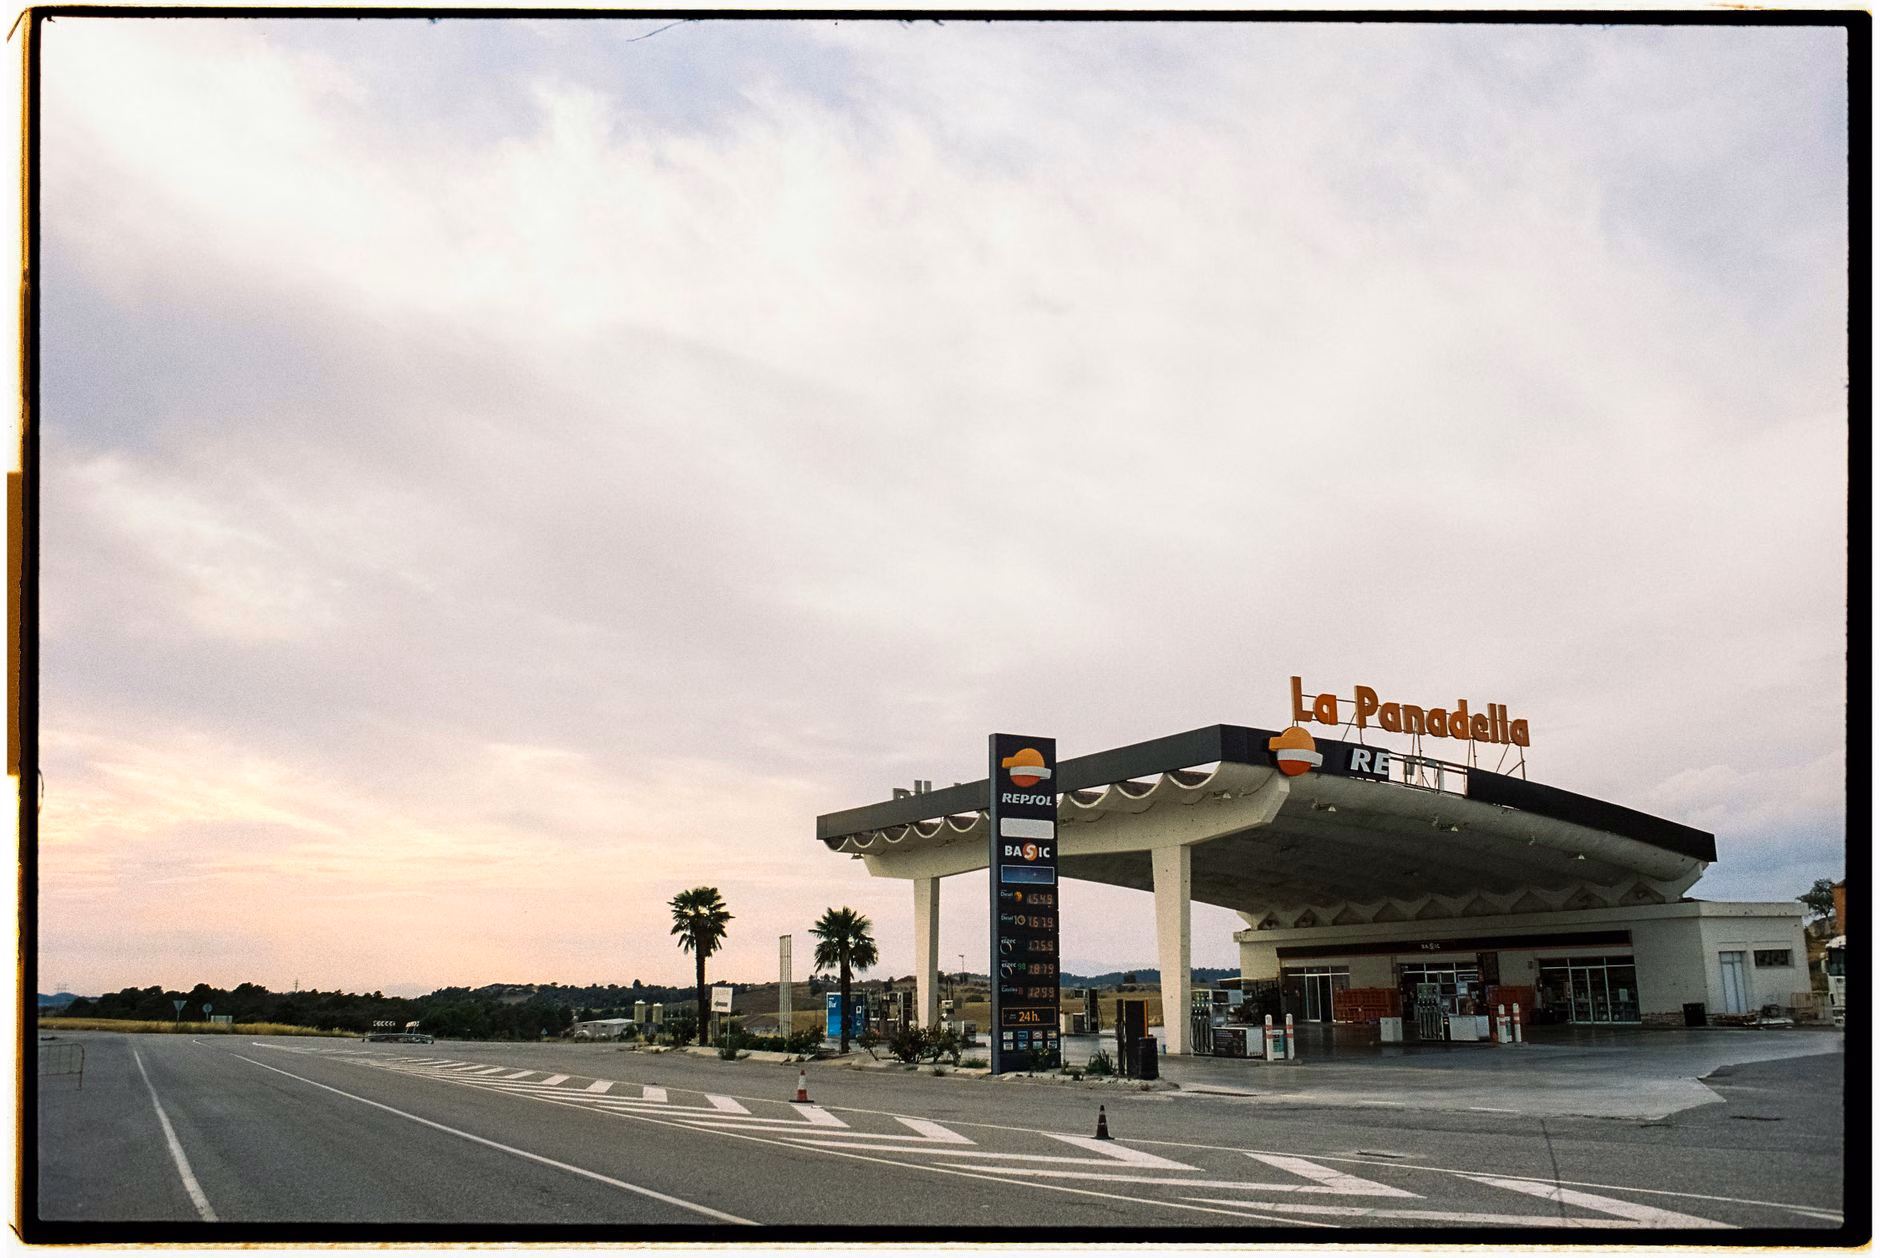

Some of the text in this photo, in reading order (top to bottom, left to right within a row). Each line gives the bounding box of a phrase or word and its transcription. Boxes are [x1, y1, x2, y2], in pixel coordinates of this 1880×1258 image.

[1290, 675, 1531, 747] La Panadella
[1002, 792, 1053, 806] REPSOL
[1004, 844, 1051, 860] BASIC
